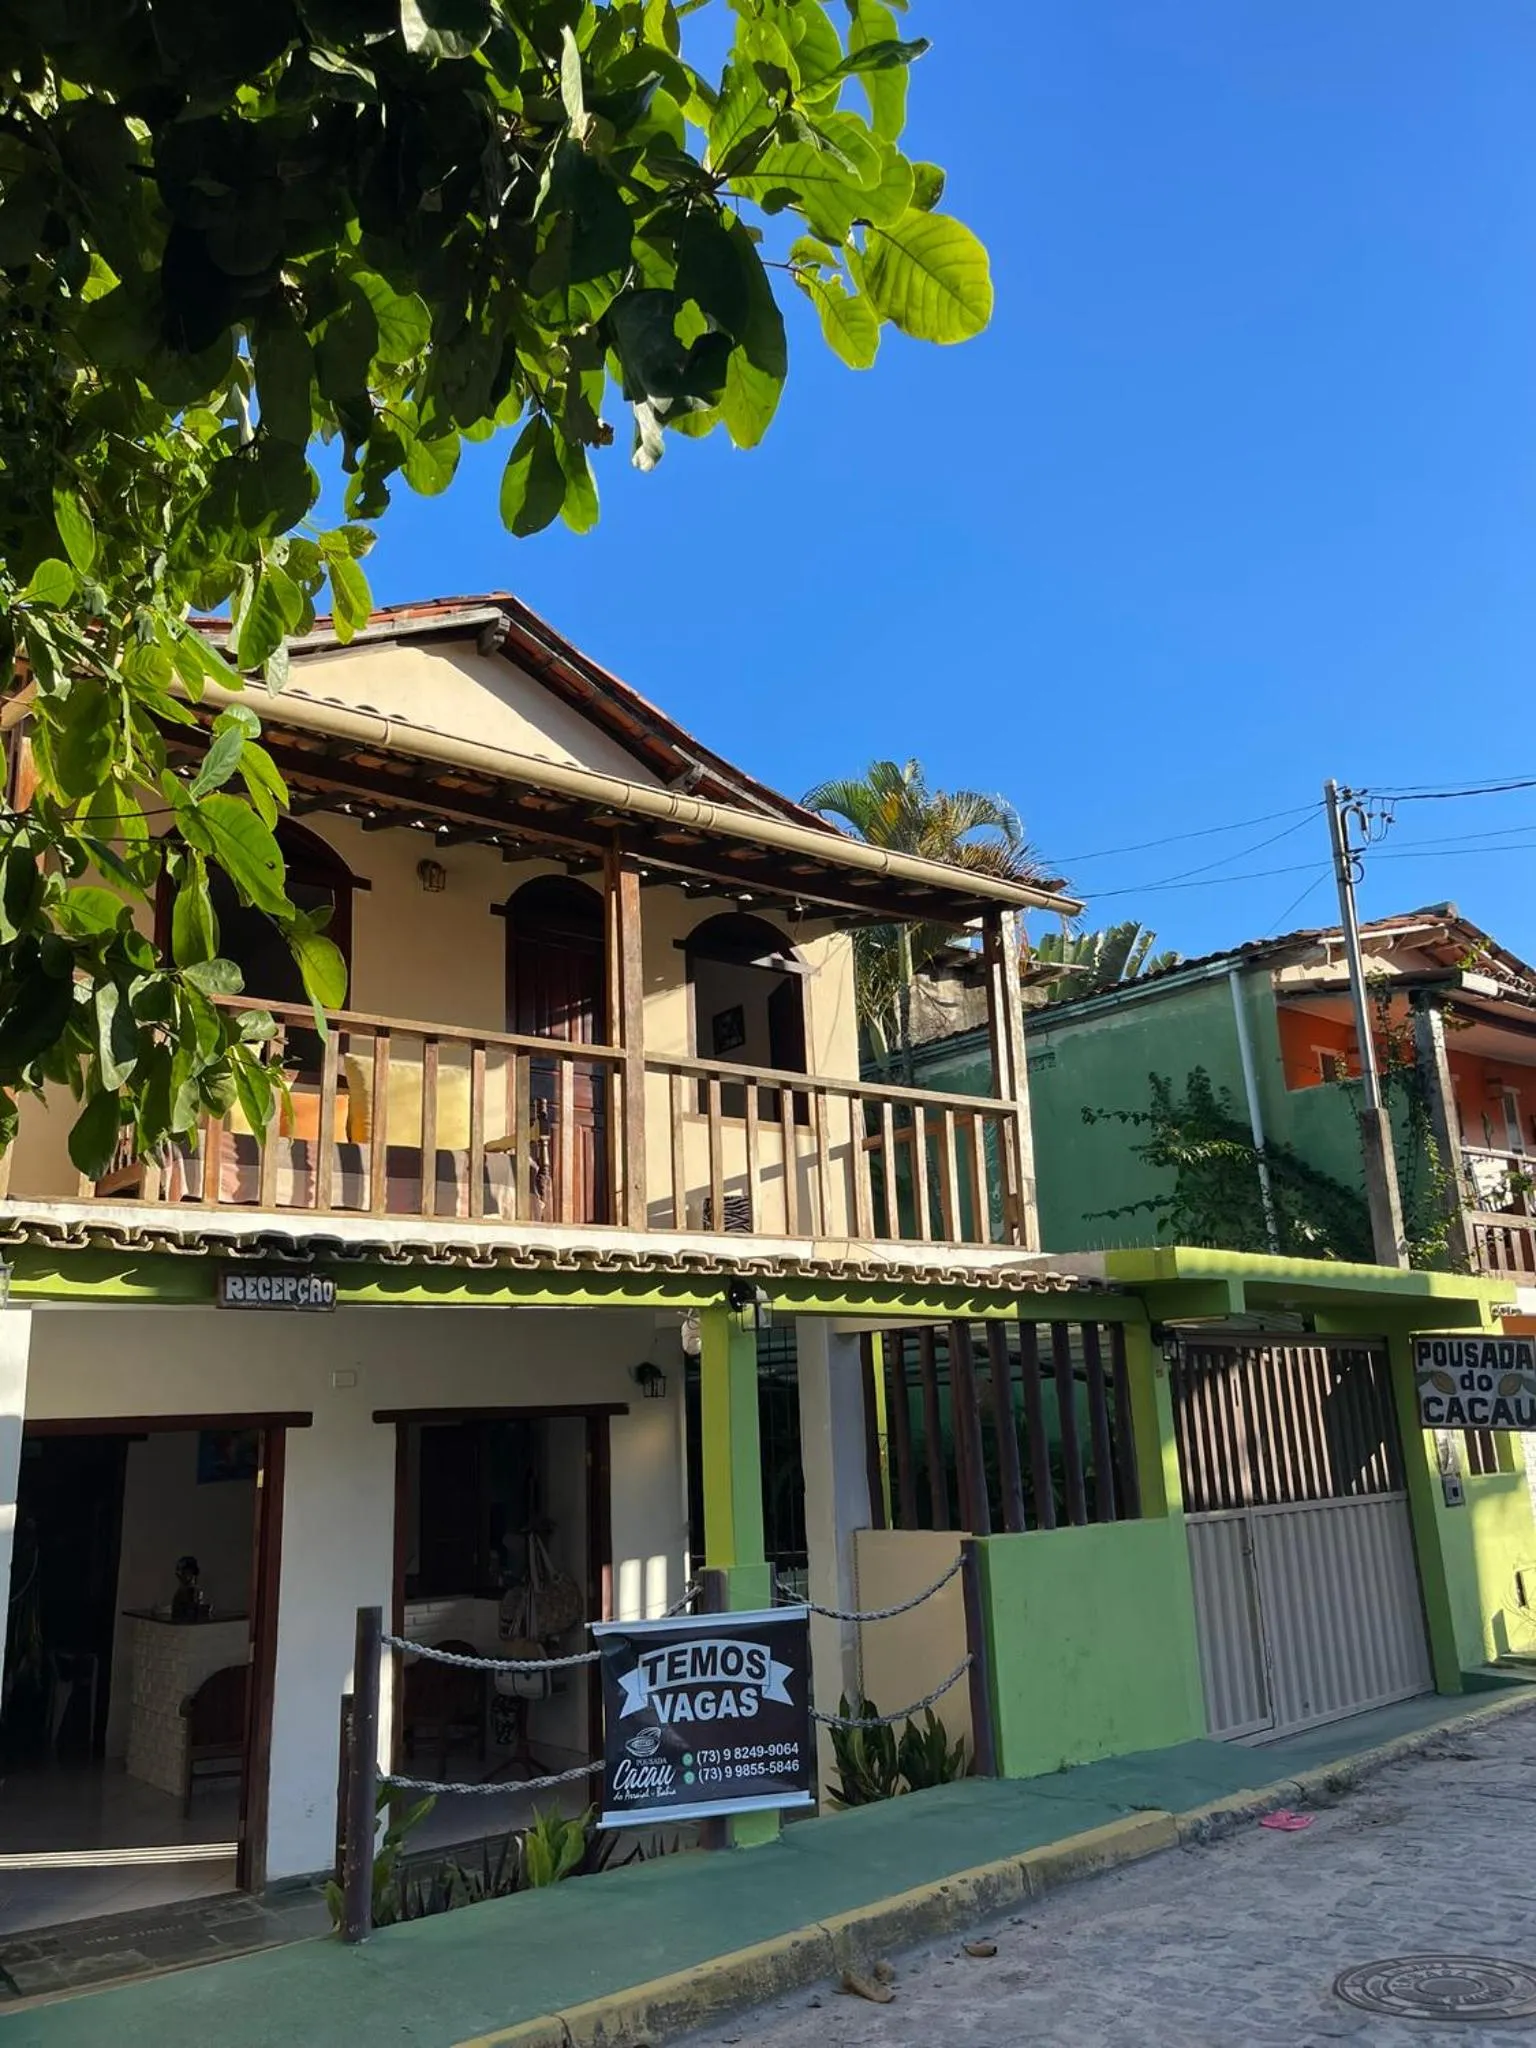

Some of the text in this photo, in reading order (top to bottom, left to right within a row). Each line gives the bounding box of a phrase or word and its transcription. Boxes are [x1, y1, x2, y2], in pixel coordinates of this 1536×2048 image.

[1417, 1341, 1533, 1369] POUSADA
[1460, 1370, 1492, 1391] do
[1424, 1396, 1536, 1427] CACAU
[641, 1645, 766, 1687] TEMOS
[652, 1687, 759, 1724] VAGAS
[697, 1742, 799, 1766] (73) 9 8249-9064
[613, 1759, 676, 1790] Cacau
[698, 1760, 800, 1785] (73) 9 9855-5846
